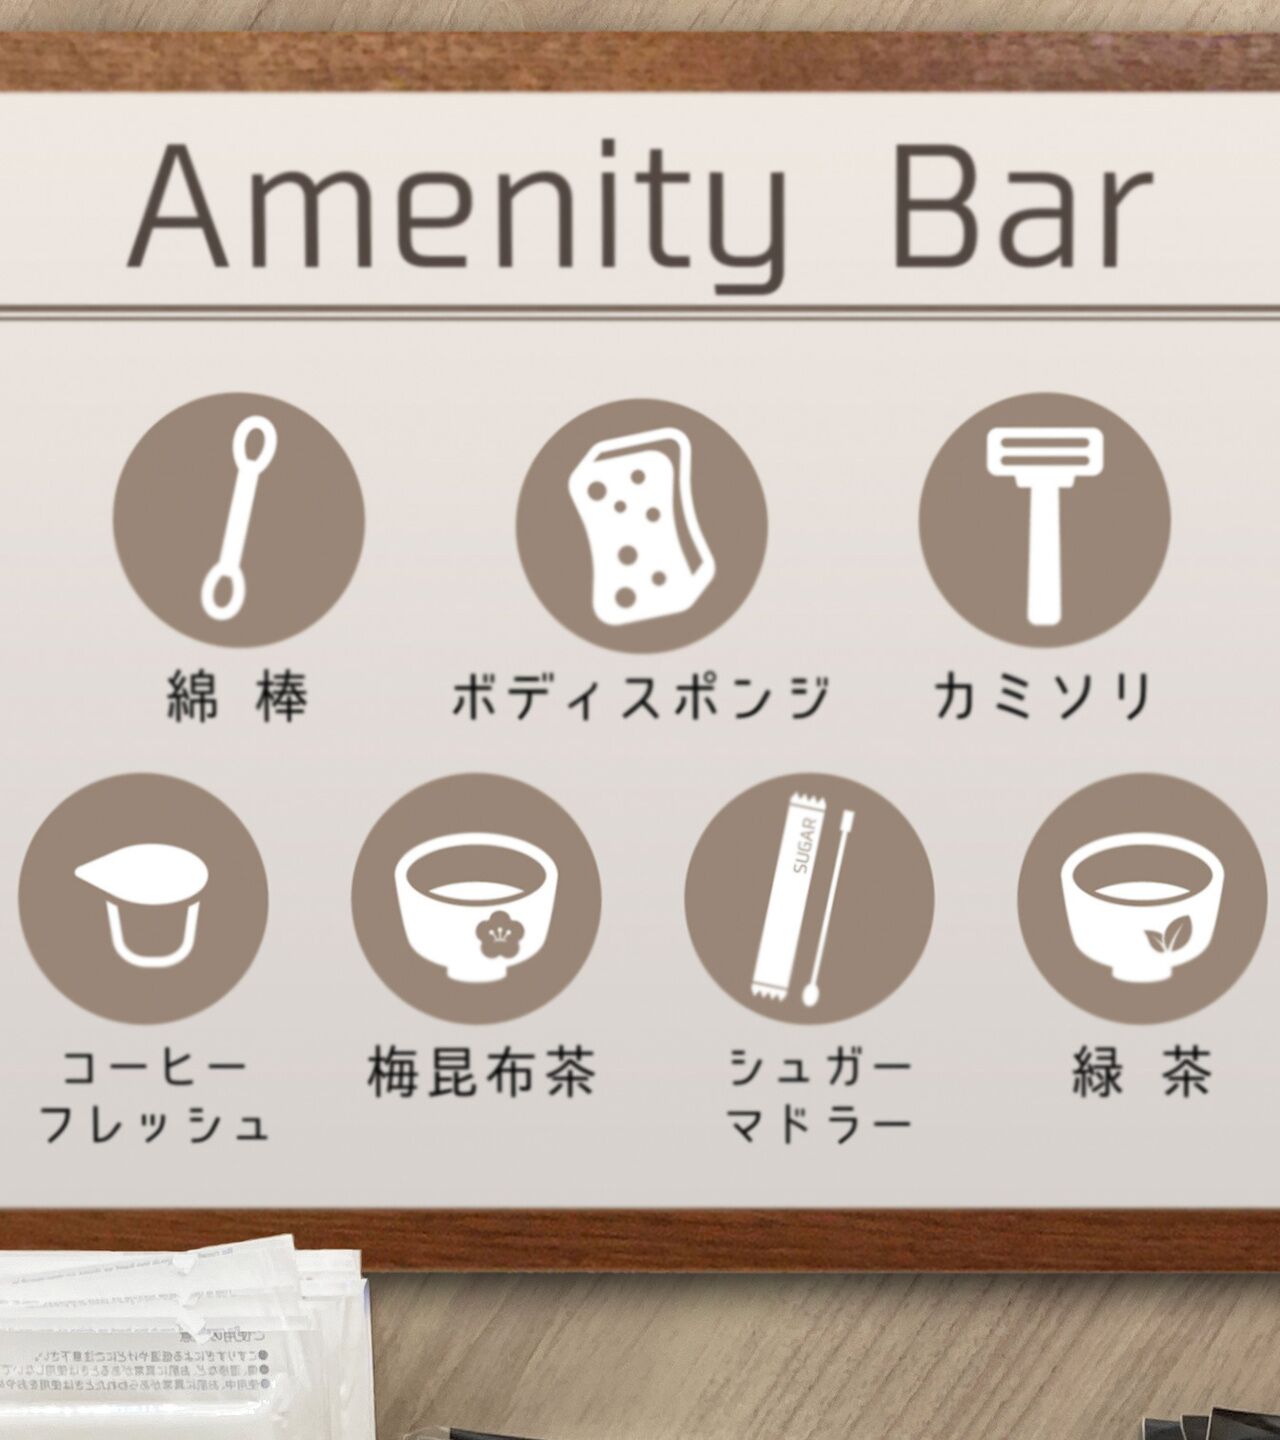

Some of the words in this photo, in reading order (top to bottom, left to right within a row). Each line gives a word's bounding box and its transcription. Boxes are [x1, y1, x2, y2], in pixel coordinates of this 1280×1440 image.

[127, 138, 786, 296] Amenity
[896, 144, 1155, 268] Bar
[452, 670, 830, 722] ボディスポンジ
[934, 670, 1150, 722] カミソリ
[793, 816, 817, 874] SUGAR
[63, 1046, 247, 1087] コーヒー
[367, 1044, 597, 1099] 梅昆布茶
[730, 1045, 912, 1087] シュガー
[40, 1105, 269, 1145] フレッシュ
[727, 1103, 912, 1145] マドラー
